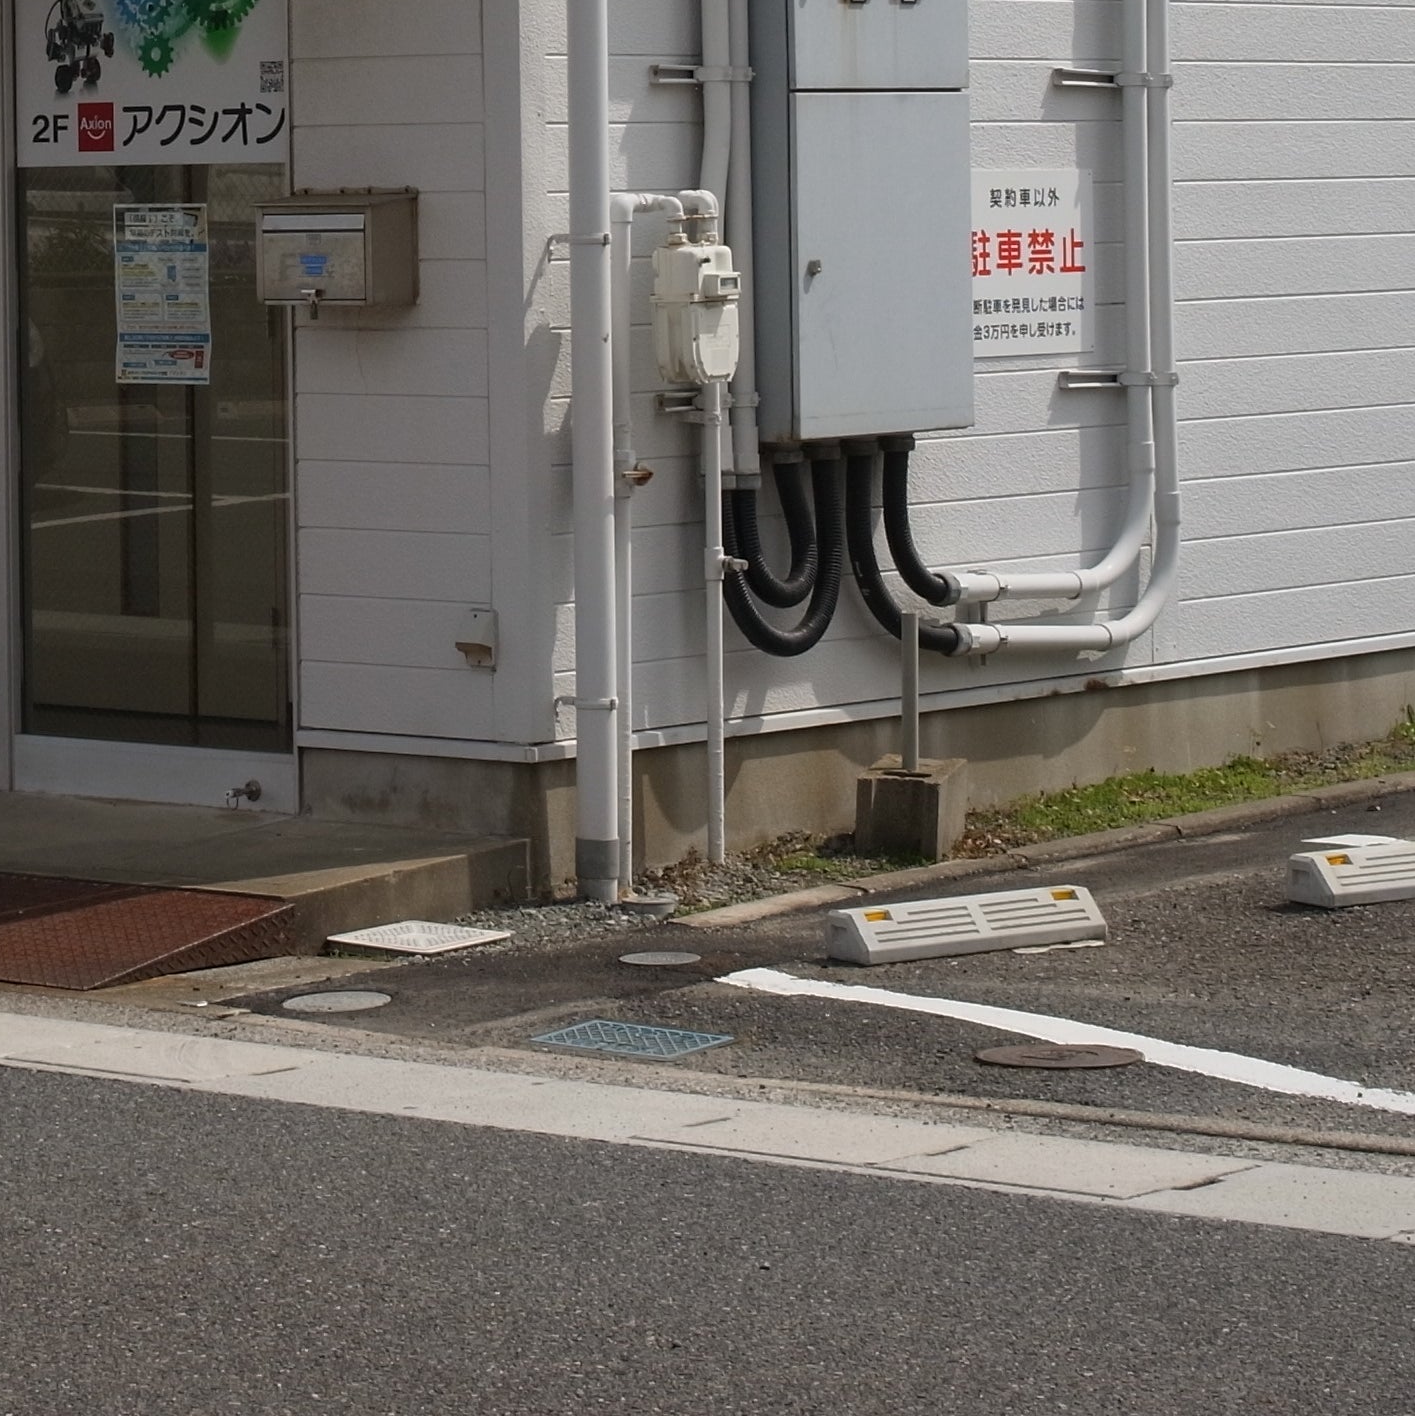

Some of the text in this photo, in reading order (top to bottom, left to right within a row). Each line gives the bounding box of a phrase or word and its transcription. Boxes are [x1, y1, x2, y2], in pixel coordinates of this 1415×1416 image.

[32, 102, 285, 147] 2F Axion アクシオン
[989, 187, 1060, 209] 契約車以外
[971, 228, 1086, 277] 駐車禁止
